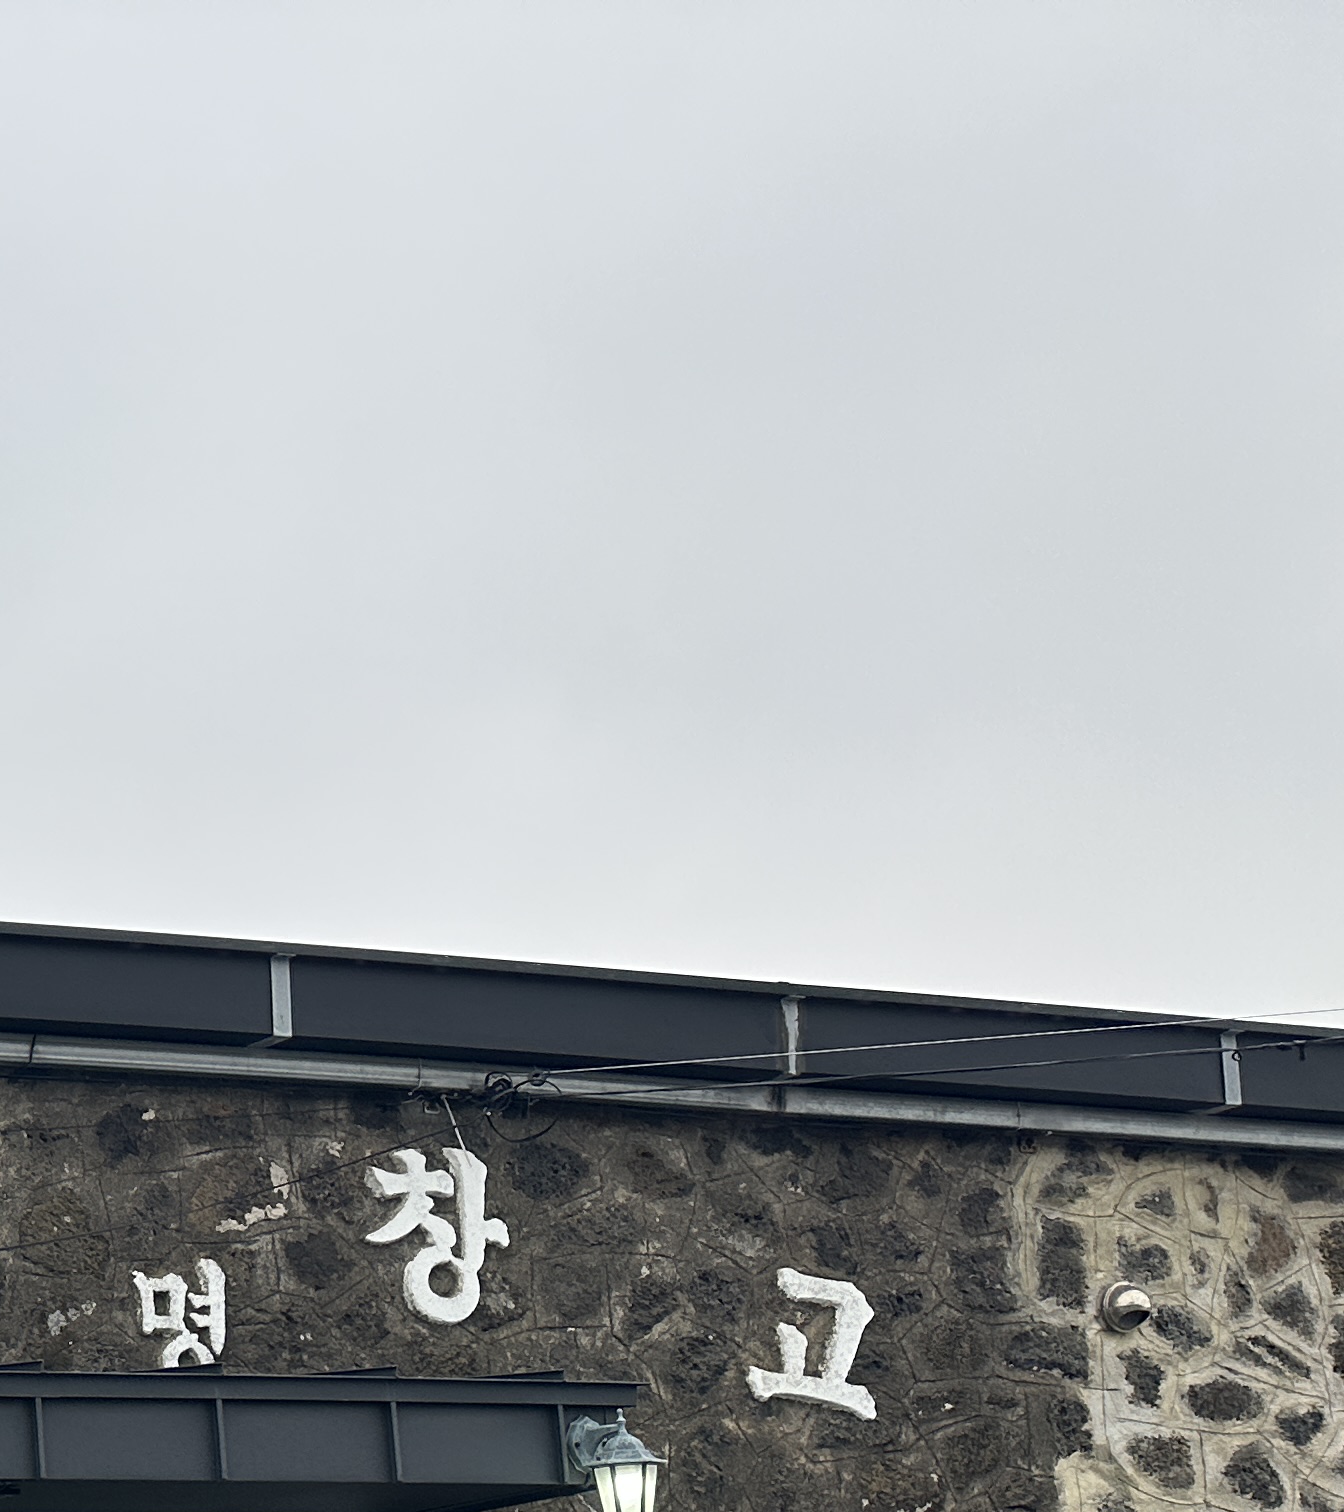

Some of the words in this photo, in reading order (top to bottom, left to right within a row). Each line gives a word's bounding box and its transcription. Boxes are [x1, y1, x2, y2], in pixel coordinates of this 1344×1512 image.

[365, 1147, 510, 1324] 창
[132, 1258, 226, 1368] 명
[746, 1267, 878, 1421] 고
